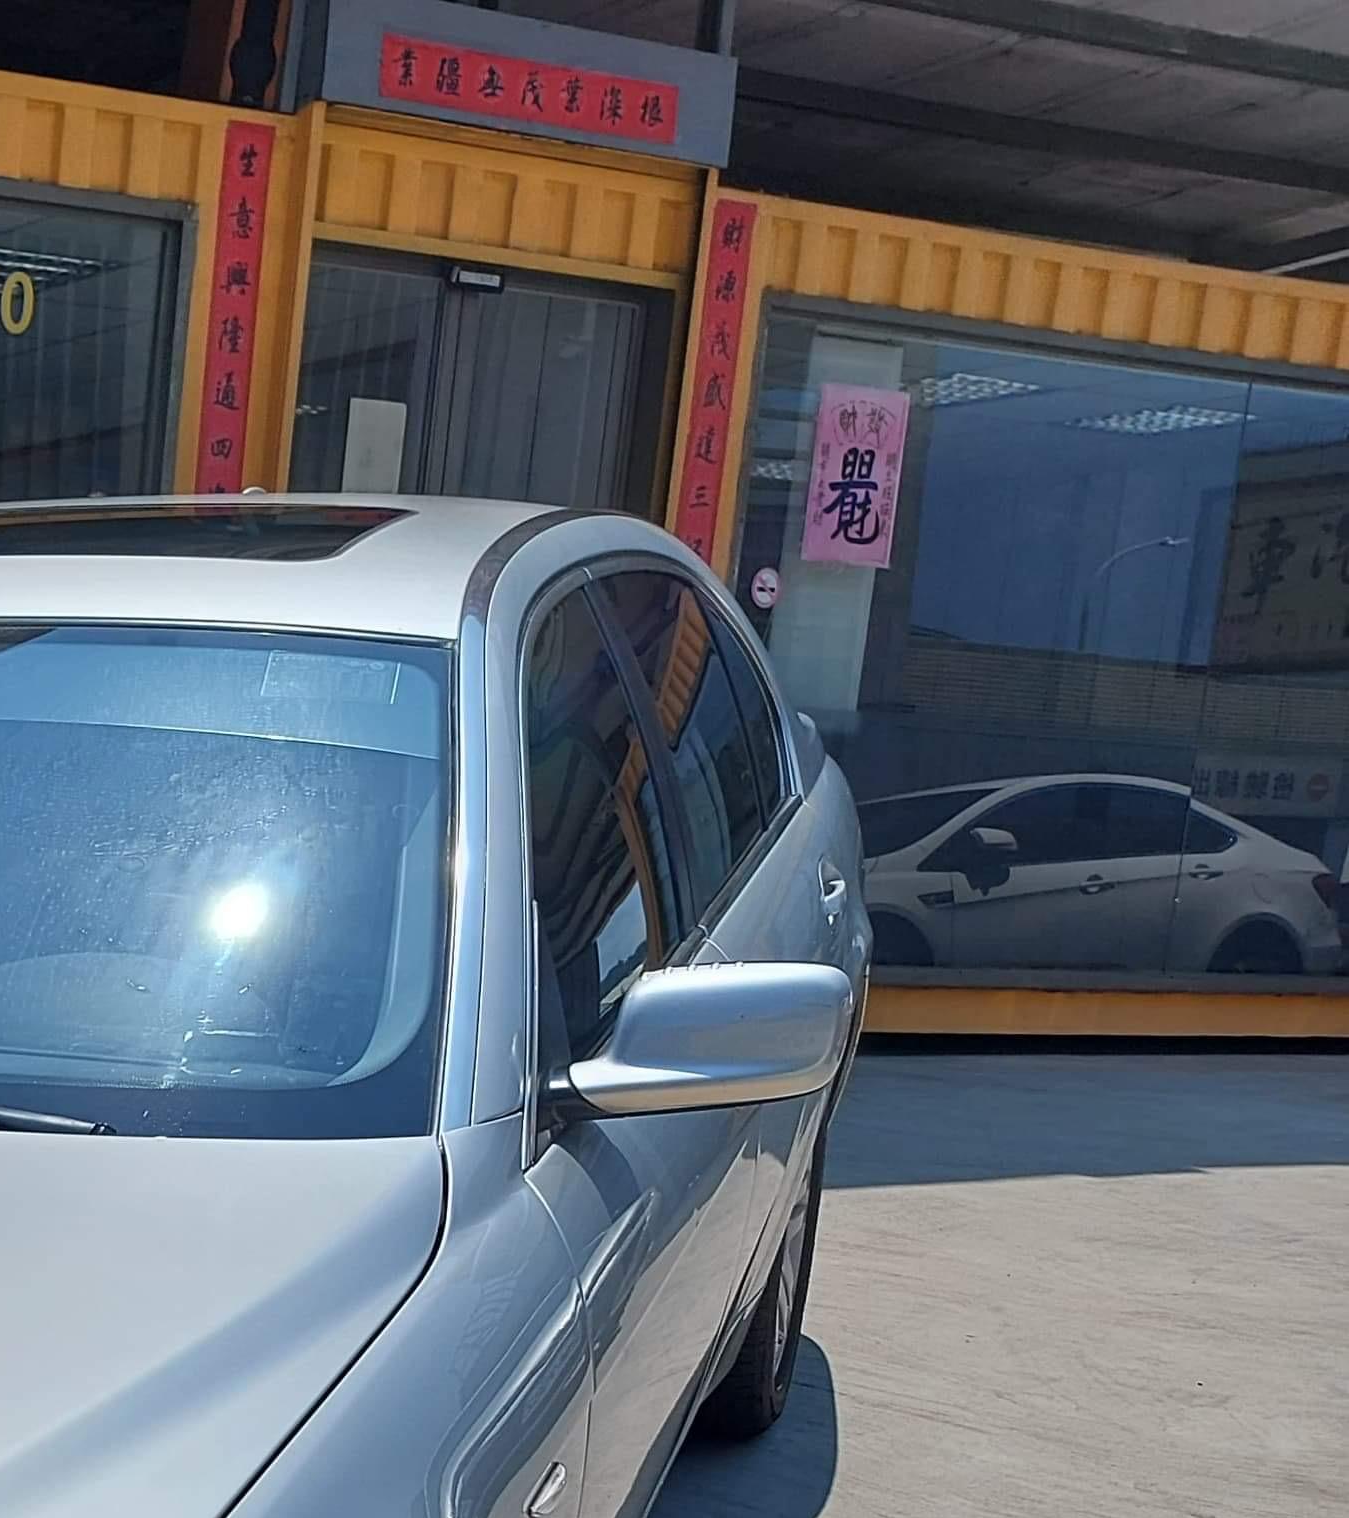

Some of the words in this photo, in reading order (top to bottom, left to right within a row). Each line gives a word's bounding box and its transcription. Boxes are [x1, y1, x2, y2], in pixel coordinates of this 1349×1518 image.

[209, 143, 258, 495] 生意興隆通四
